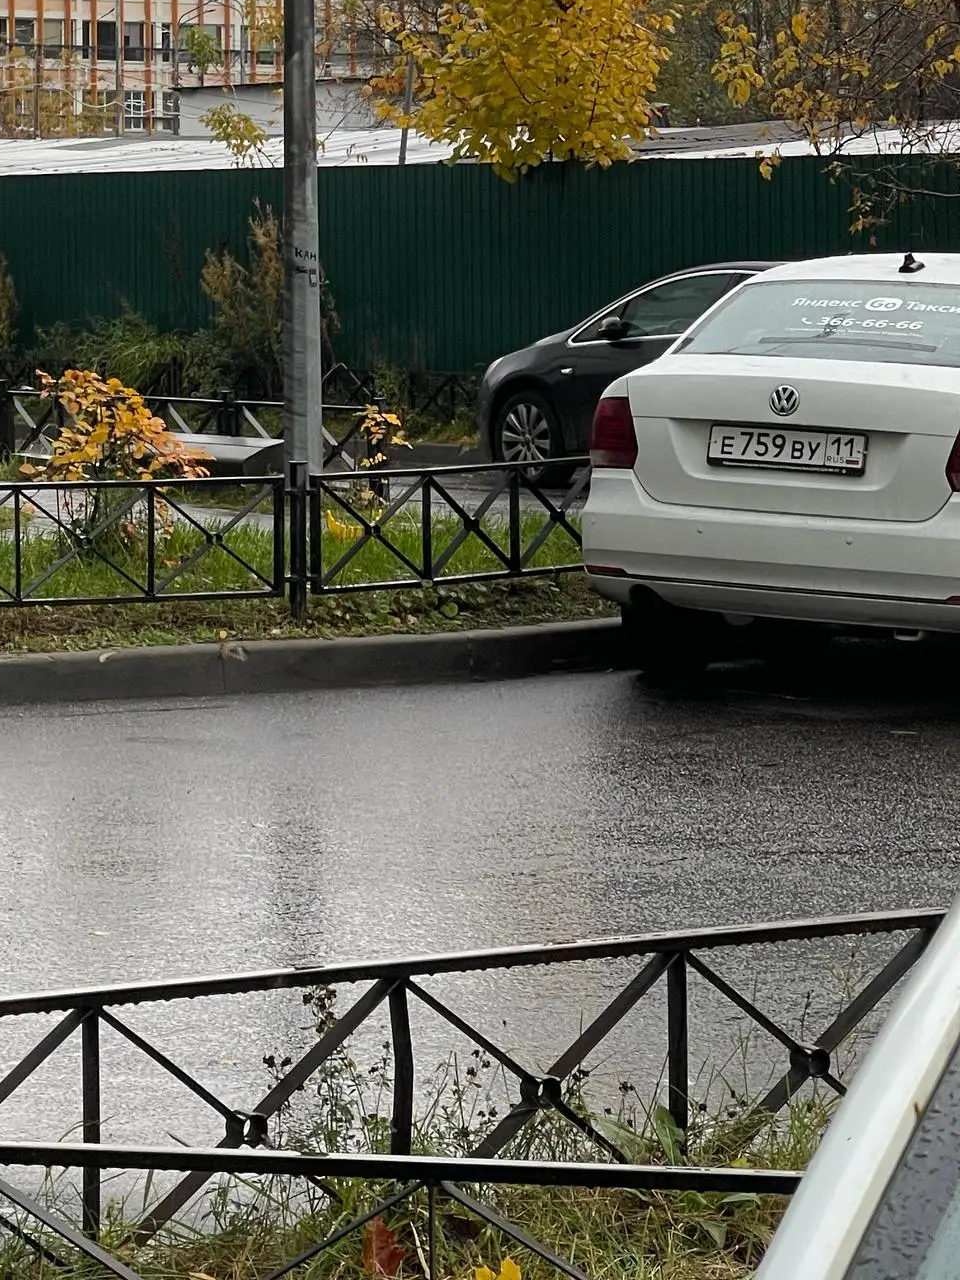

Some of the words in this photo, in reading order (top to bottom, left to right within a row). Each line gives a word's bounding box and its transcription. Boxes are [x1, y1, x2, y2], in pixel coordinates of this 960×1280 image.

[791, 297, 863, 308] Яндекс
[907, 301, 960, 313] Такси
[816, 316, 924, 330] 366-66-66
[831, 436, 856, 457] 11
[826, 456, 845, 464] RUS
